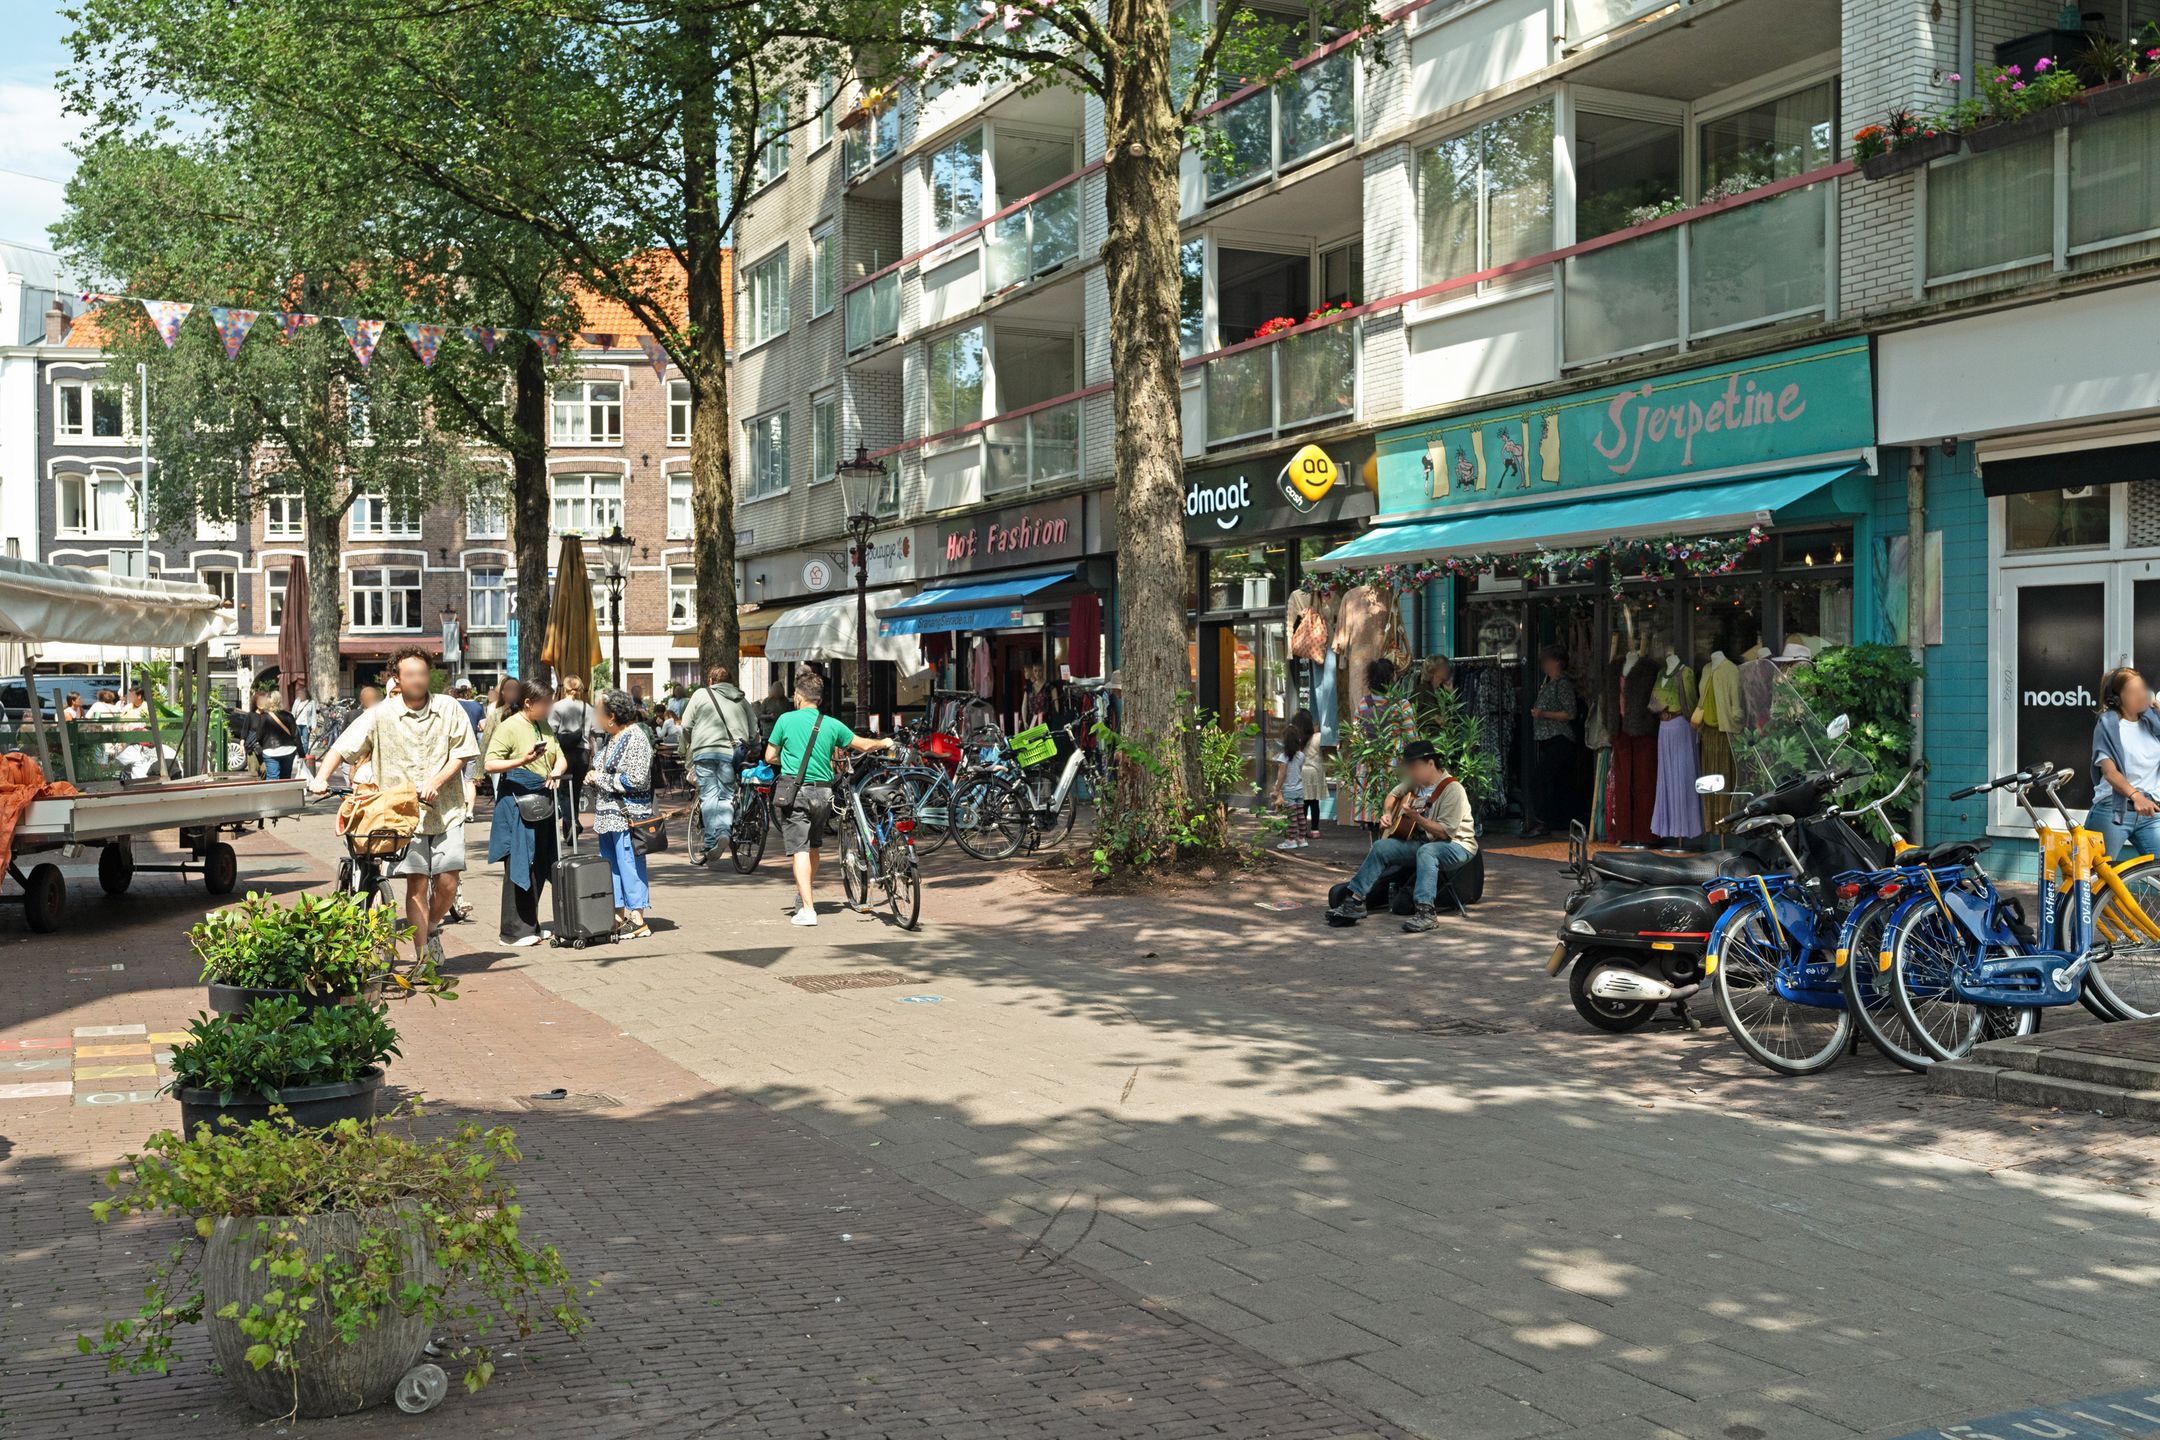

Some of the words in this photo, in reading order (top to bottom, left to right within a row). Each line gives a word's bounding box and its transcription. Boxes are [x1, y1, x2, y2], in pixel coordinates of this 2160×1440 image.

[1592, 372, 1806, 475] Sjerpetine
[1185, 476, 1250, 516] dmaat
[1285, 485, 1303, 506] cash
[946, 529, 977, 561] Hot
[987, 516, 1068, 555] Fashion
[2023, 685, 2097, 707] noosh.
[2045, 868, 2056, 924] OV-fiets.nl
[2082, 868, 2092, 924] OV-fiets.nl
